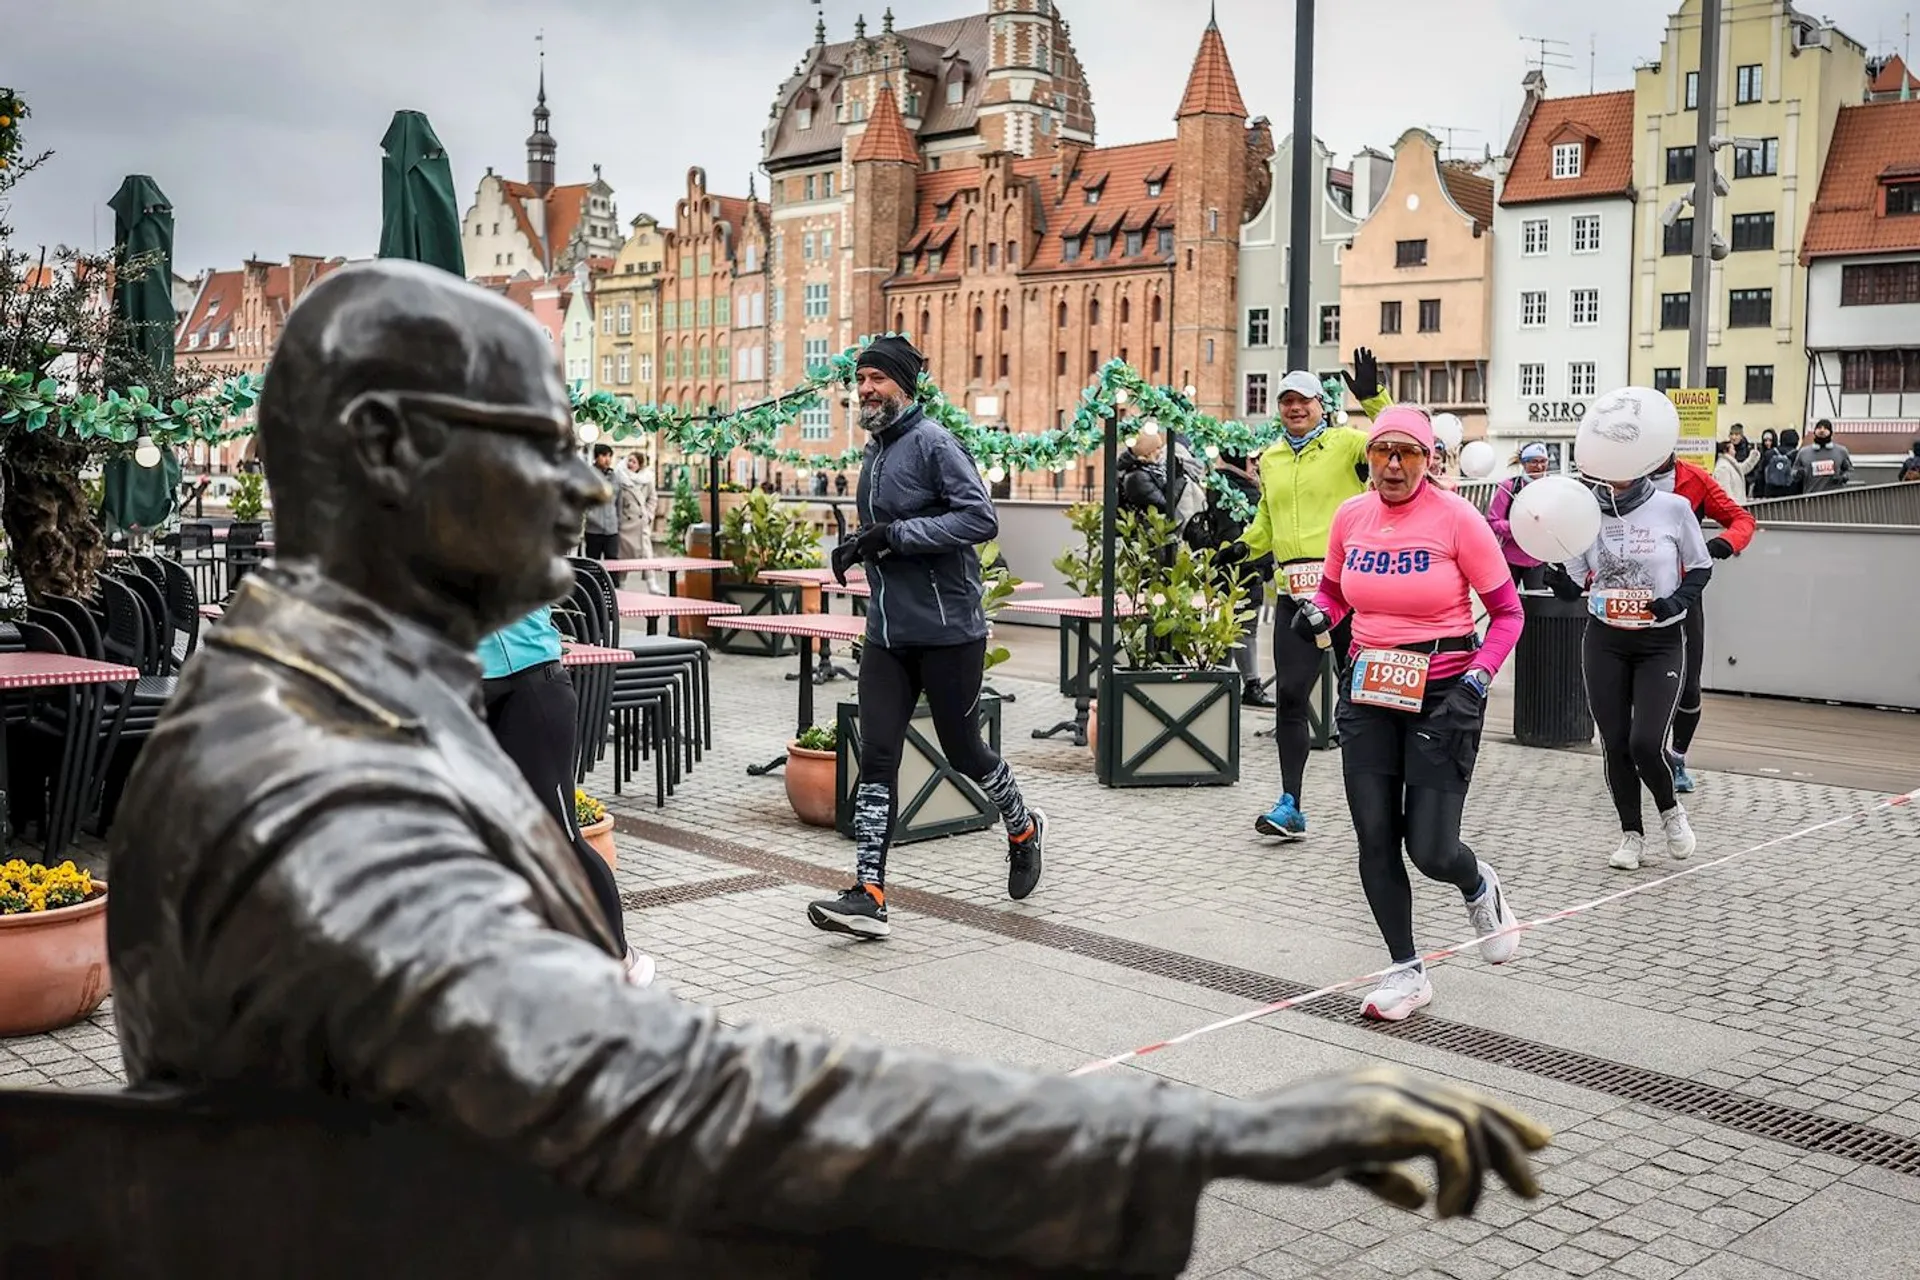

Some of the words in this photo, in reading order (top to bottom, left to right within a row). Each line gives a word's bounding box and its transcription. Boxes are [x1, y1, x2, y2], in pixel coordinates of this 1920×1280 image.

[1674, 392, 1711, 405] UWAGA
[1528, 402, 1587, 417] OSTRO
[1625, 589, 1649, 598] 2025
[1392, 653, 1428, 667] 2025
[1355, 671, 1363, 684] F
[1369, 663, 1420, 688] 1980
